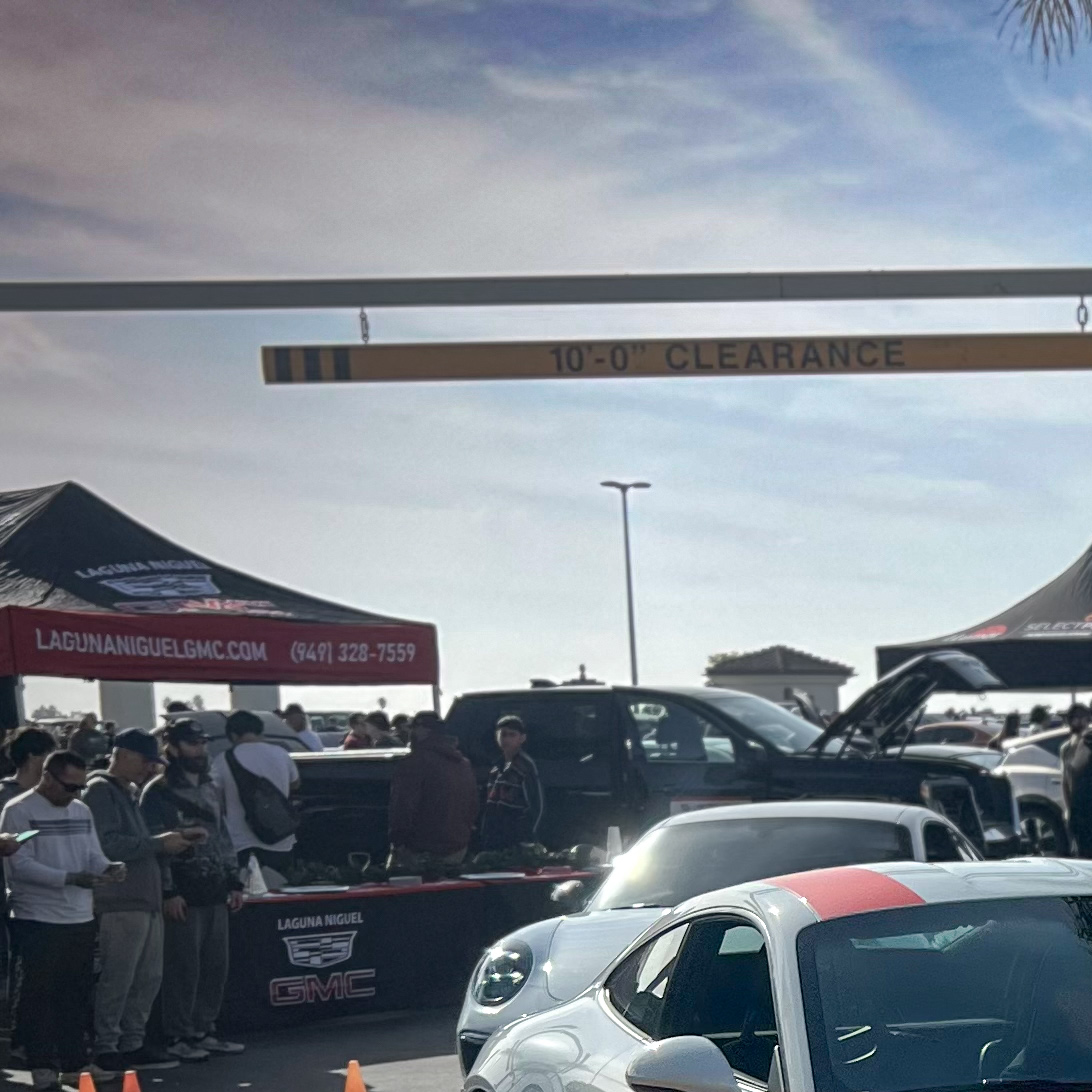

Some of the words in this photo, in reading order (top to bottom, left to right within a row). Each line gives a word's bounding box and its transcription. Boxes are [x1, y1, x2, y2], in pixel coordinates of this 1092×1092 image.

[665, 340, 905, 371] CLEARANCE
[75, 562, 144, 579] LAGUNA
[36, 628, 267, 661] LAGUNANIGUELGMC.COM
[291, 643, 332, 664] (949)
[337, 643, 416, 663] 328-7559
[277, 915, 323, 930] LAGUNA
[324, 912, 364, 926] NIGUEL
[269, 968, 376, 1006] GMC
